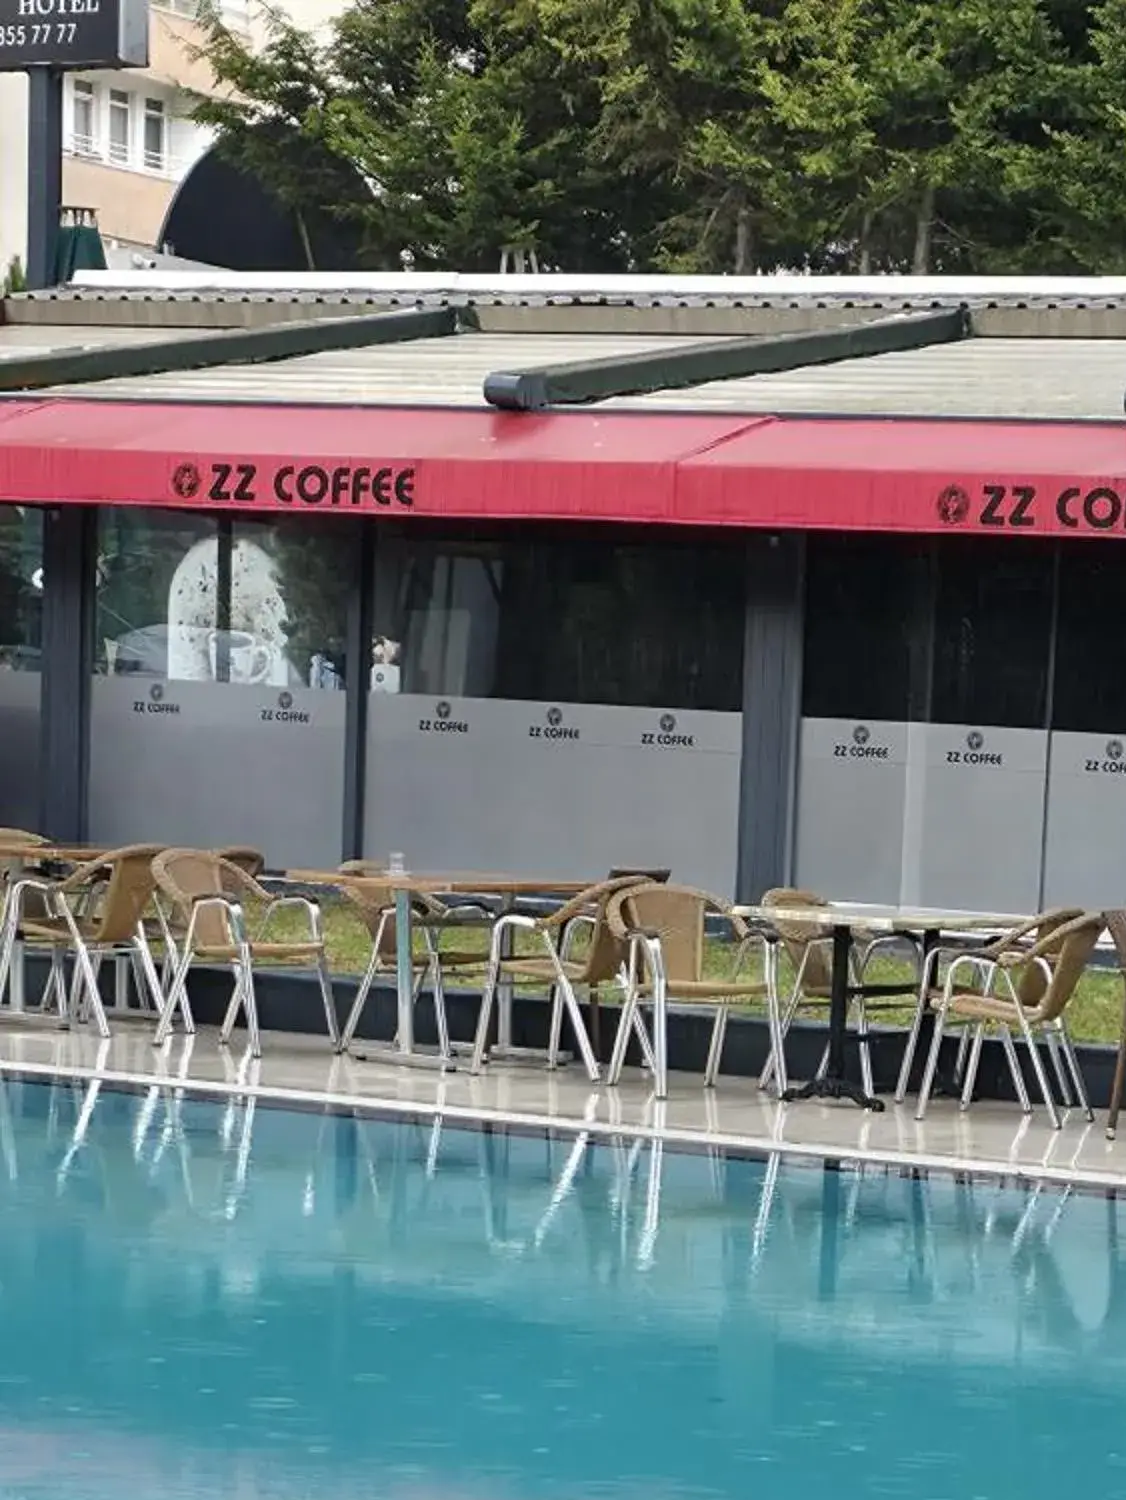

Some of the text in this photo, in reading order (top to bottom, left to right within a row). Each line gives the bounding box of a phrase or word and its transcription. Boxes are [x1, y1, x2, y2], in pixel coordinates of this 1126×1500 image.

[31, 24, 51, 45] 77
[56, 22, 77, 44] 77
[208, 463, 415, 505] ZZ COFFEE
[979, 485, 1036, 526] ZZ
[133, 701, 180, 715] ZZ COFFEE
[261, 709, 310, 724] ZZ COFFEE
[419, 719, 469, 733] ZZ COFFEE
[528, 726, 580, 740] ZZ COFFEE
[641, 733, 694, 747] ZZ COFFEE
[833, 745, 889, 759] ZZ COFFEE
[946, 751, 1002, 766] ZZ COFFEE
[1084, 759, 1100, 772] ZZ
